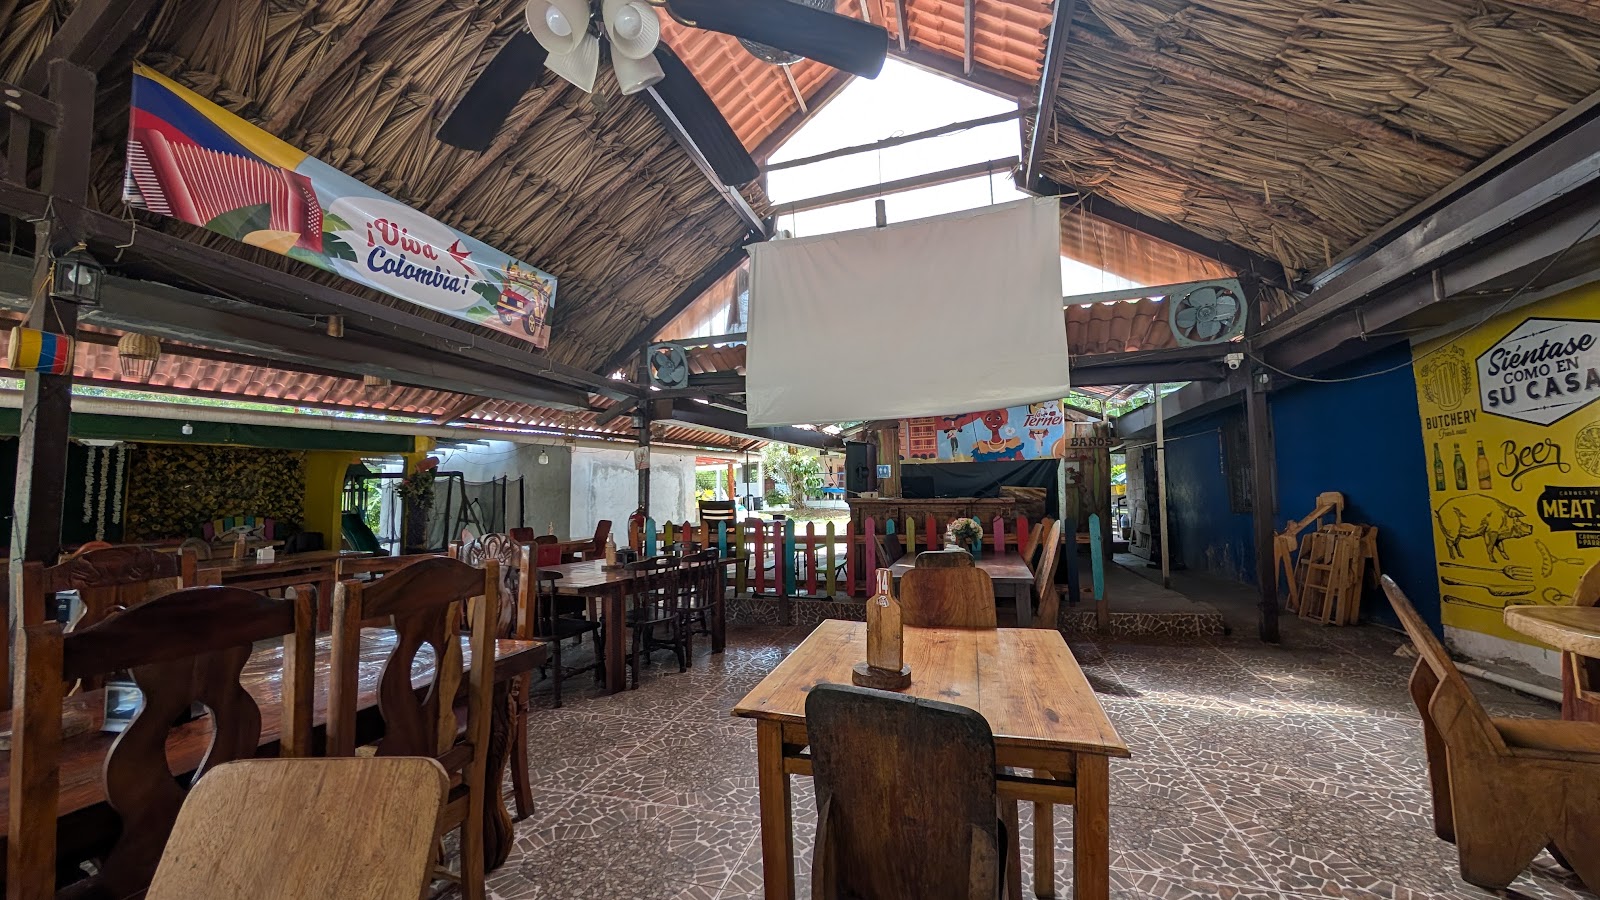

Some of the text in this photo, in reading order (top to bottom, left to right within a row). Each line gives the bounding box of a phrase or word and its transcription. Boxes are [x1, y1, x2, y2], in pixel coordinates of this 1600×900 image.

[367, 245, 470, 294] Colombia!
[1487, 333, 1598, 376] Siéntase
[1503, 356, 1579, 384] COMO EN
[1487, 367, 1600, 407] SU CASA
[1425, 408, 1477, 429] BUTCHERY
[1496, 437, 1571, 492] Beer
[876, 570, 889, 595] 14
